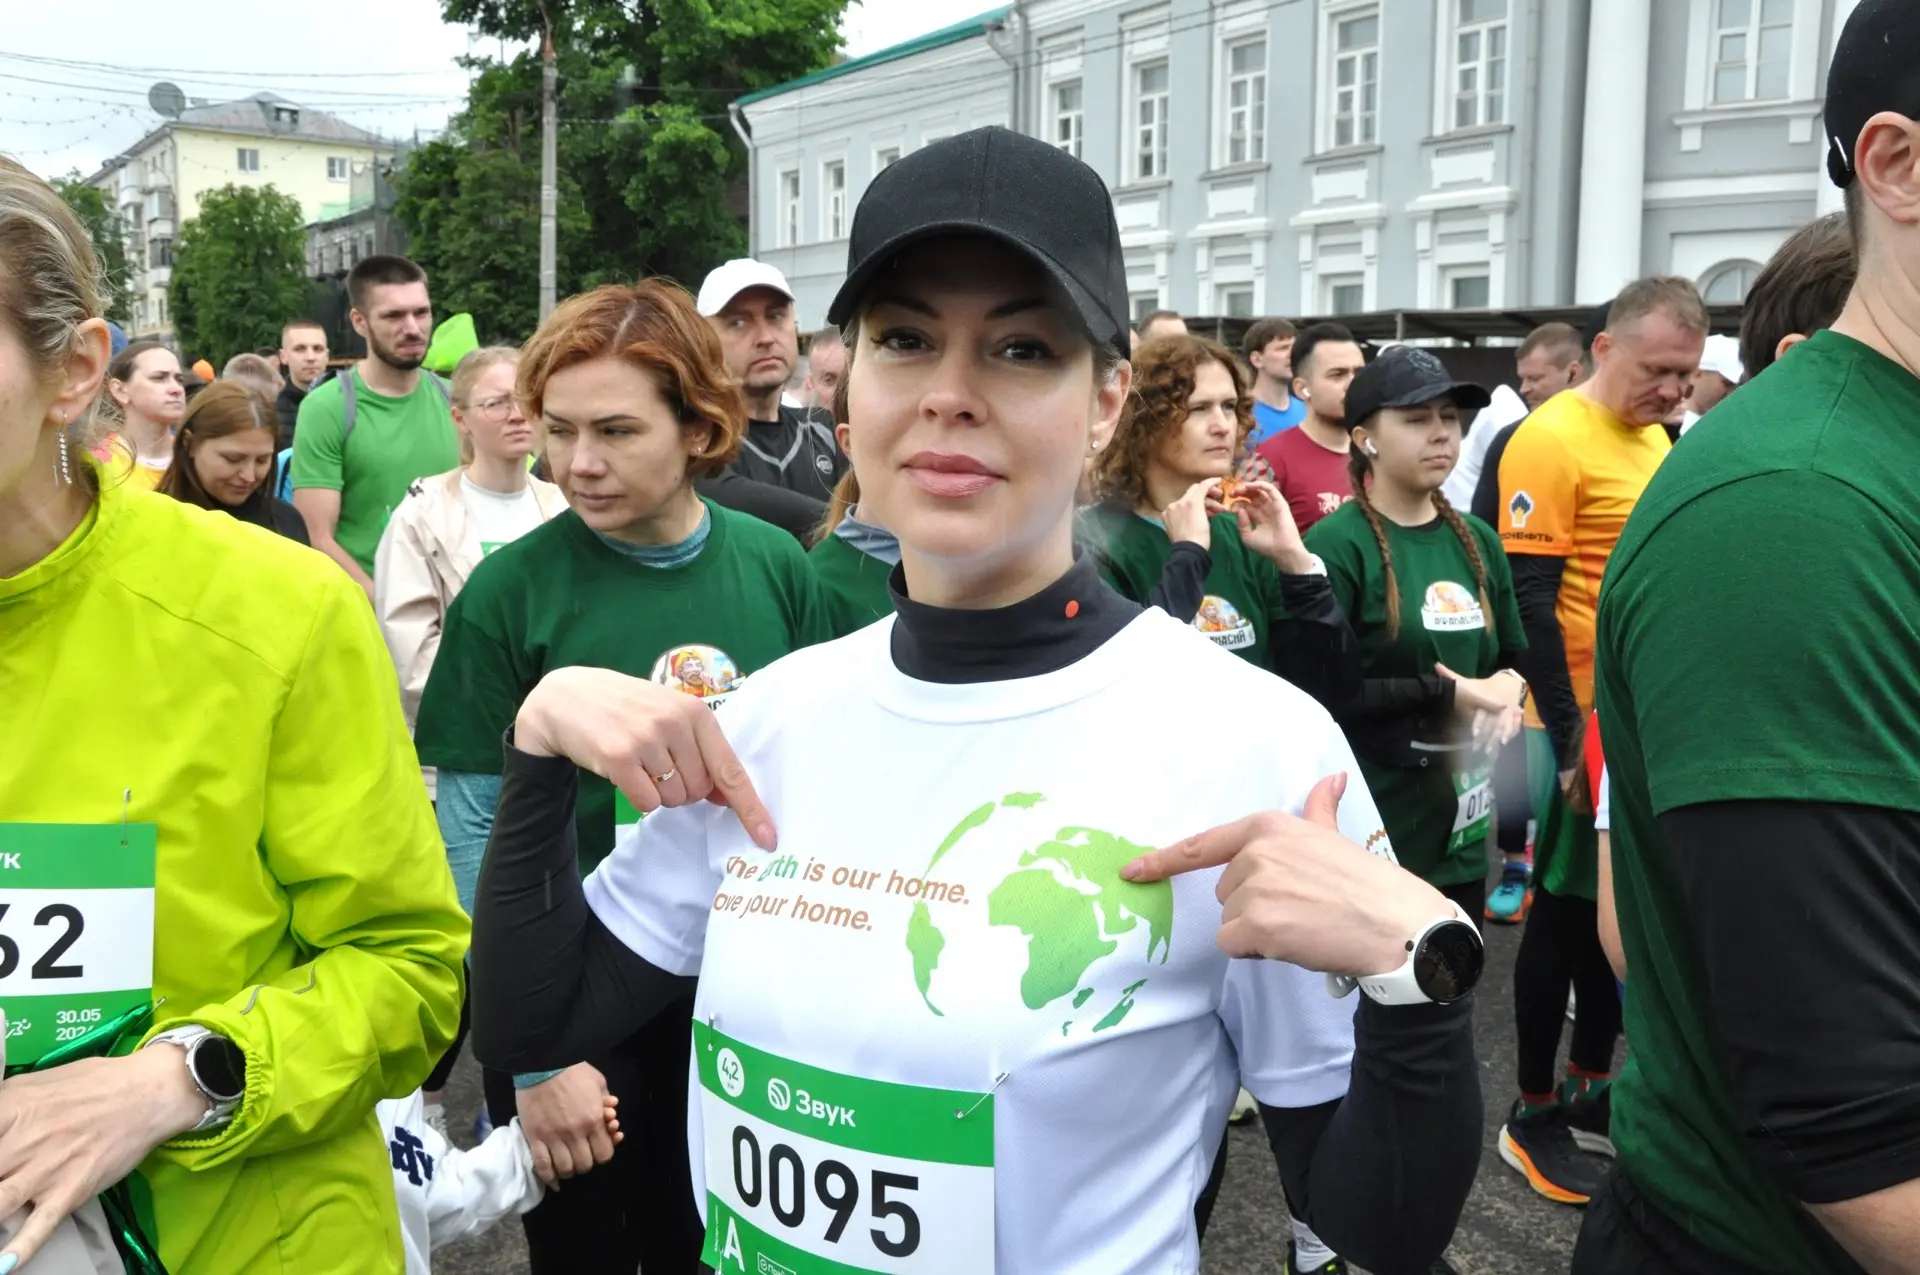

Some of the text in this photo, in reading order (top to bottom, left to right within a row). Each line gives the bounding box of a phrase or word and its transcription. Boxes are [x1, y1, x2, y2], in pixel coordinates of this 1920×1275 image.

[803, 857, 825, 882] is
[831, 866, 881, 890] our
[885, 869, 970, 905] home.
[713, 892, 744, 912] ove
[790, 894, 873, 932] home.
[56, 1008, 101, 1025] 30.05
[722, 1057, 739, 1081] 4,2
[795, 1089, 856, 1128] Звук
[732, 1125, 921, 1258] 0095
